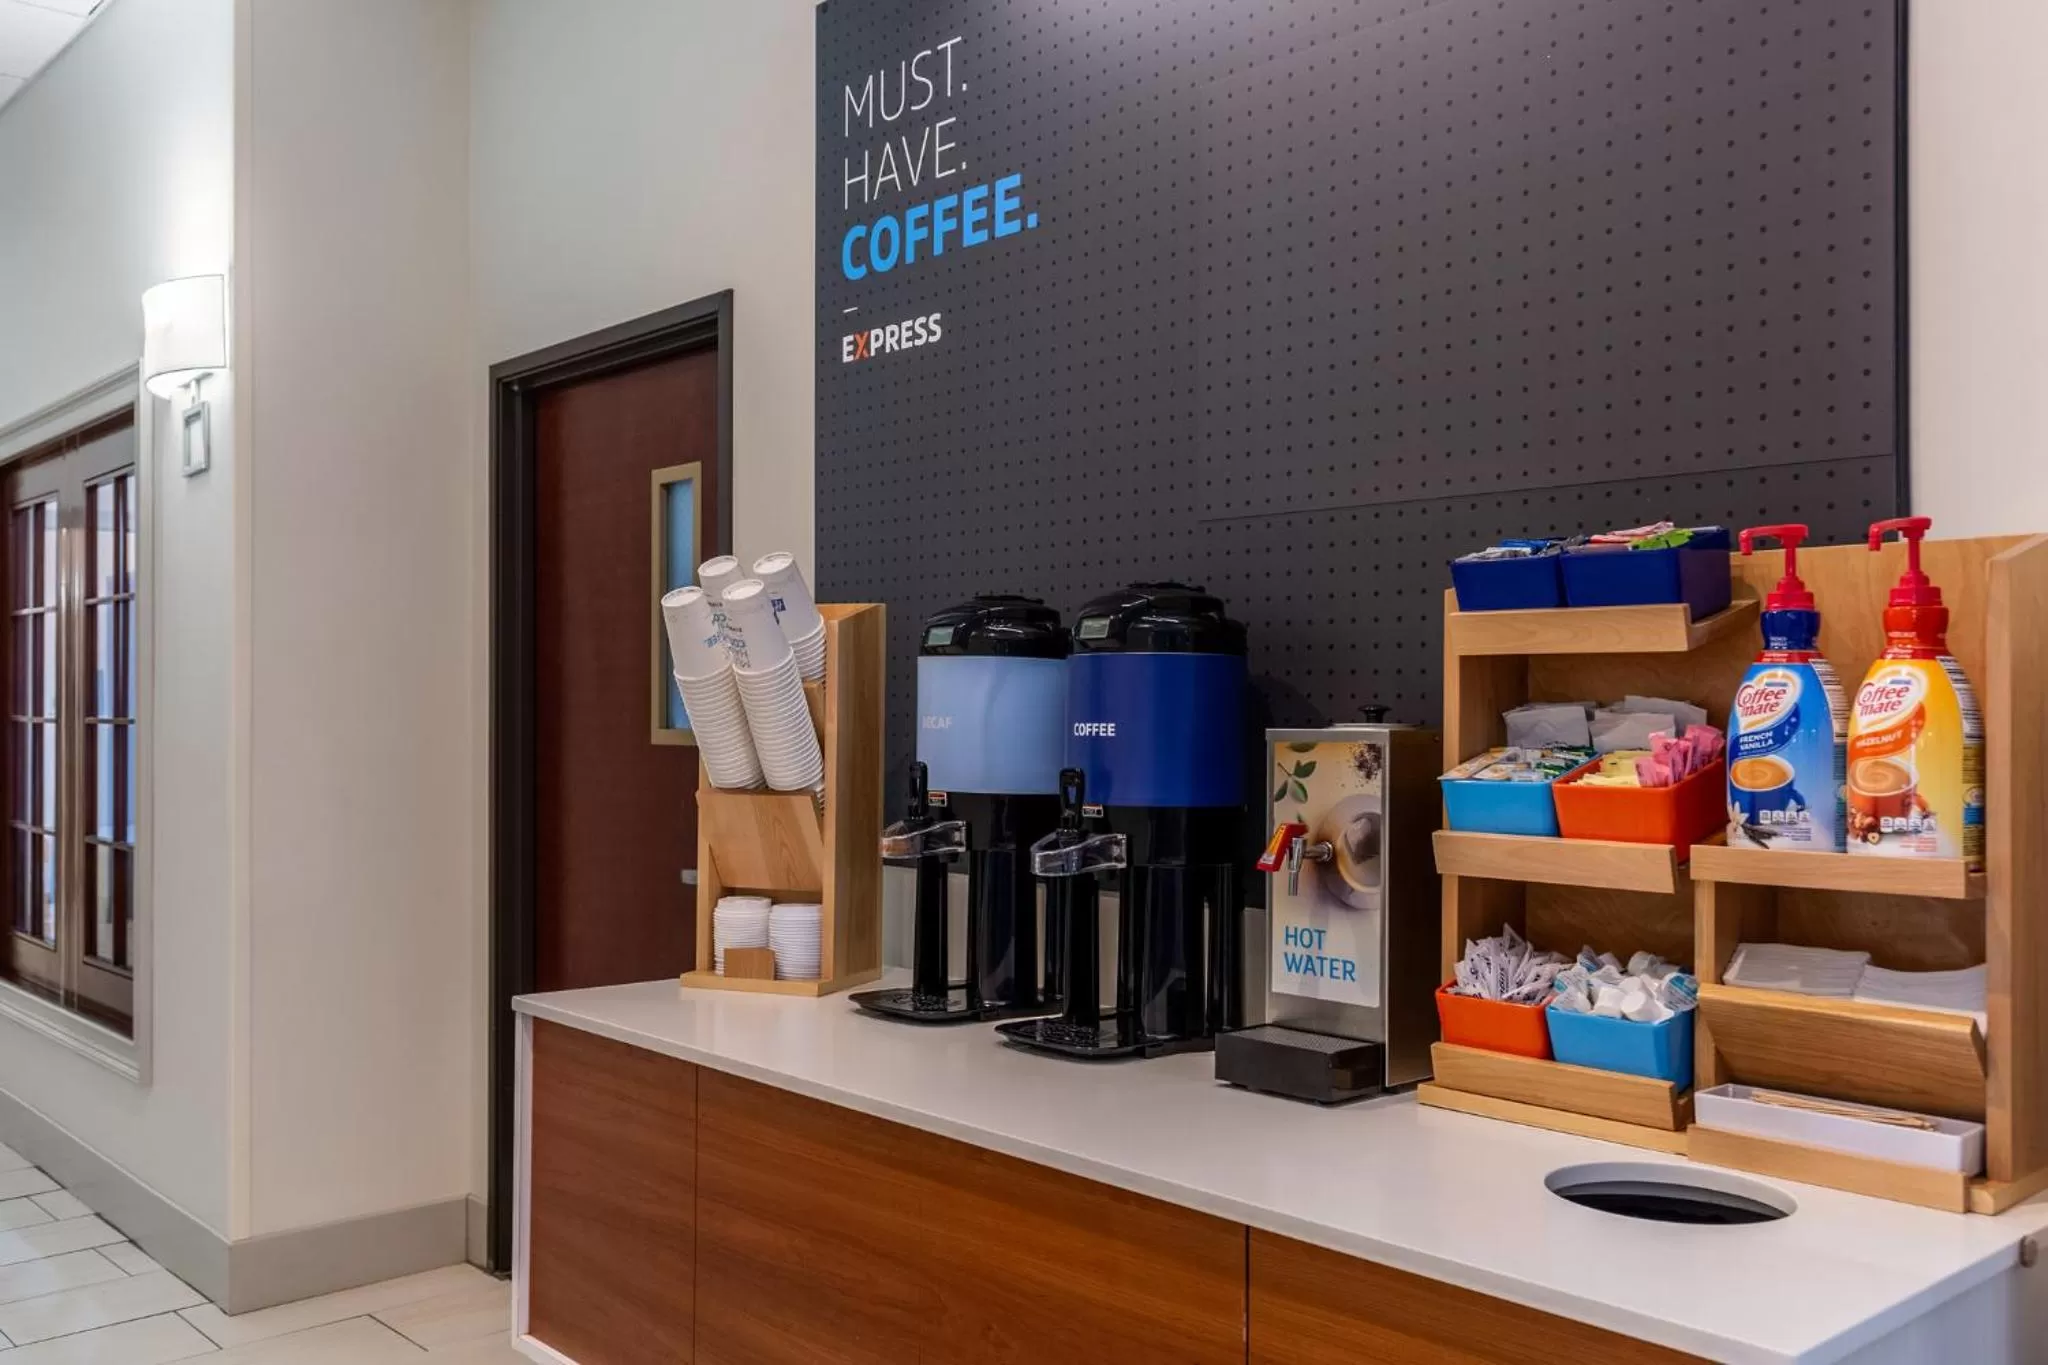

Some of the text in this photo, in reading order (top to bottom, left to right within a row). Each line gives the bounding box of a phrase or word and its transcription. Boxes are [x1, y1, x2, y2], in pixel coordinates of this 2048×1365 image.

[844, 36, 968, 138] MUST.
[844, 116, 968, 211] HAVE.
[841, 172, 1040, 281] COFFEE.
[842, 312, 943, 364] EXPRESS
[1073, 722, 1116, 737] COFFEE
[1739, 730, 1774, 743] FRENCH
[1739, 738, 1775, 751] VANILLA
[1284, 925, 1327, 951] HOT
[1283, 951, 1357, 983] WATER
